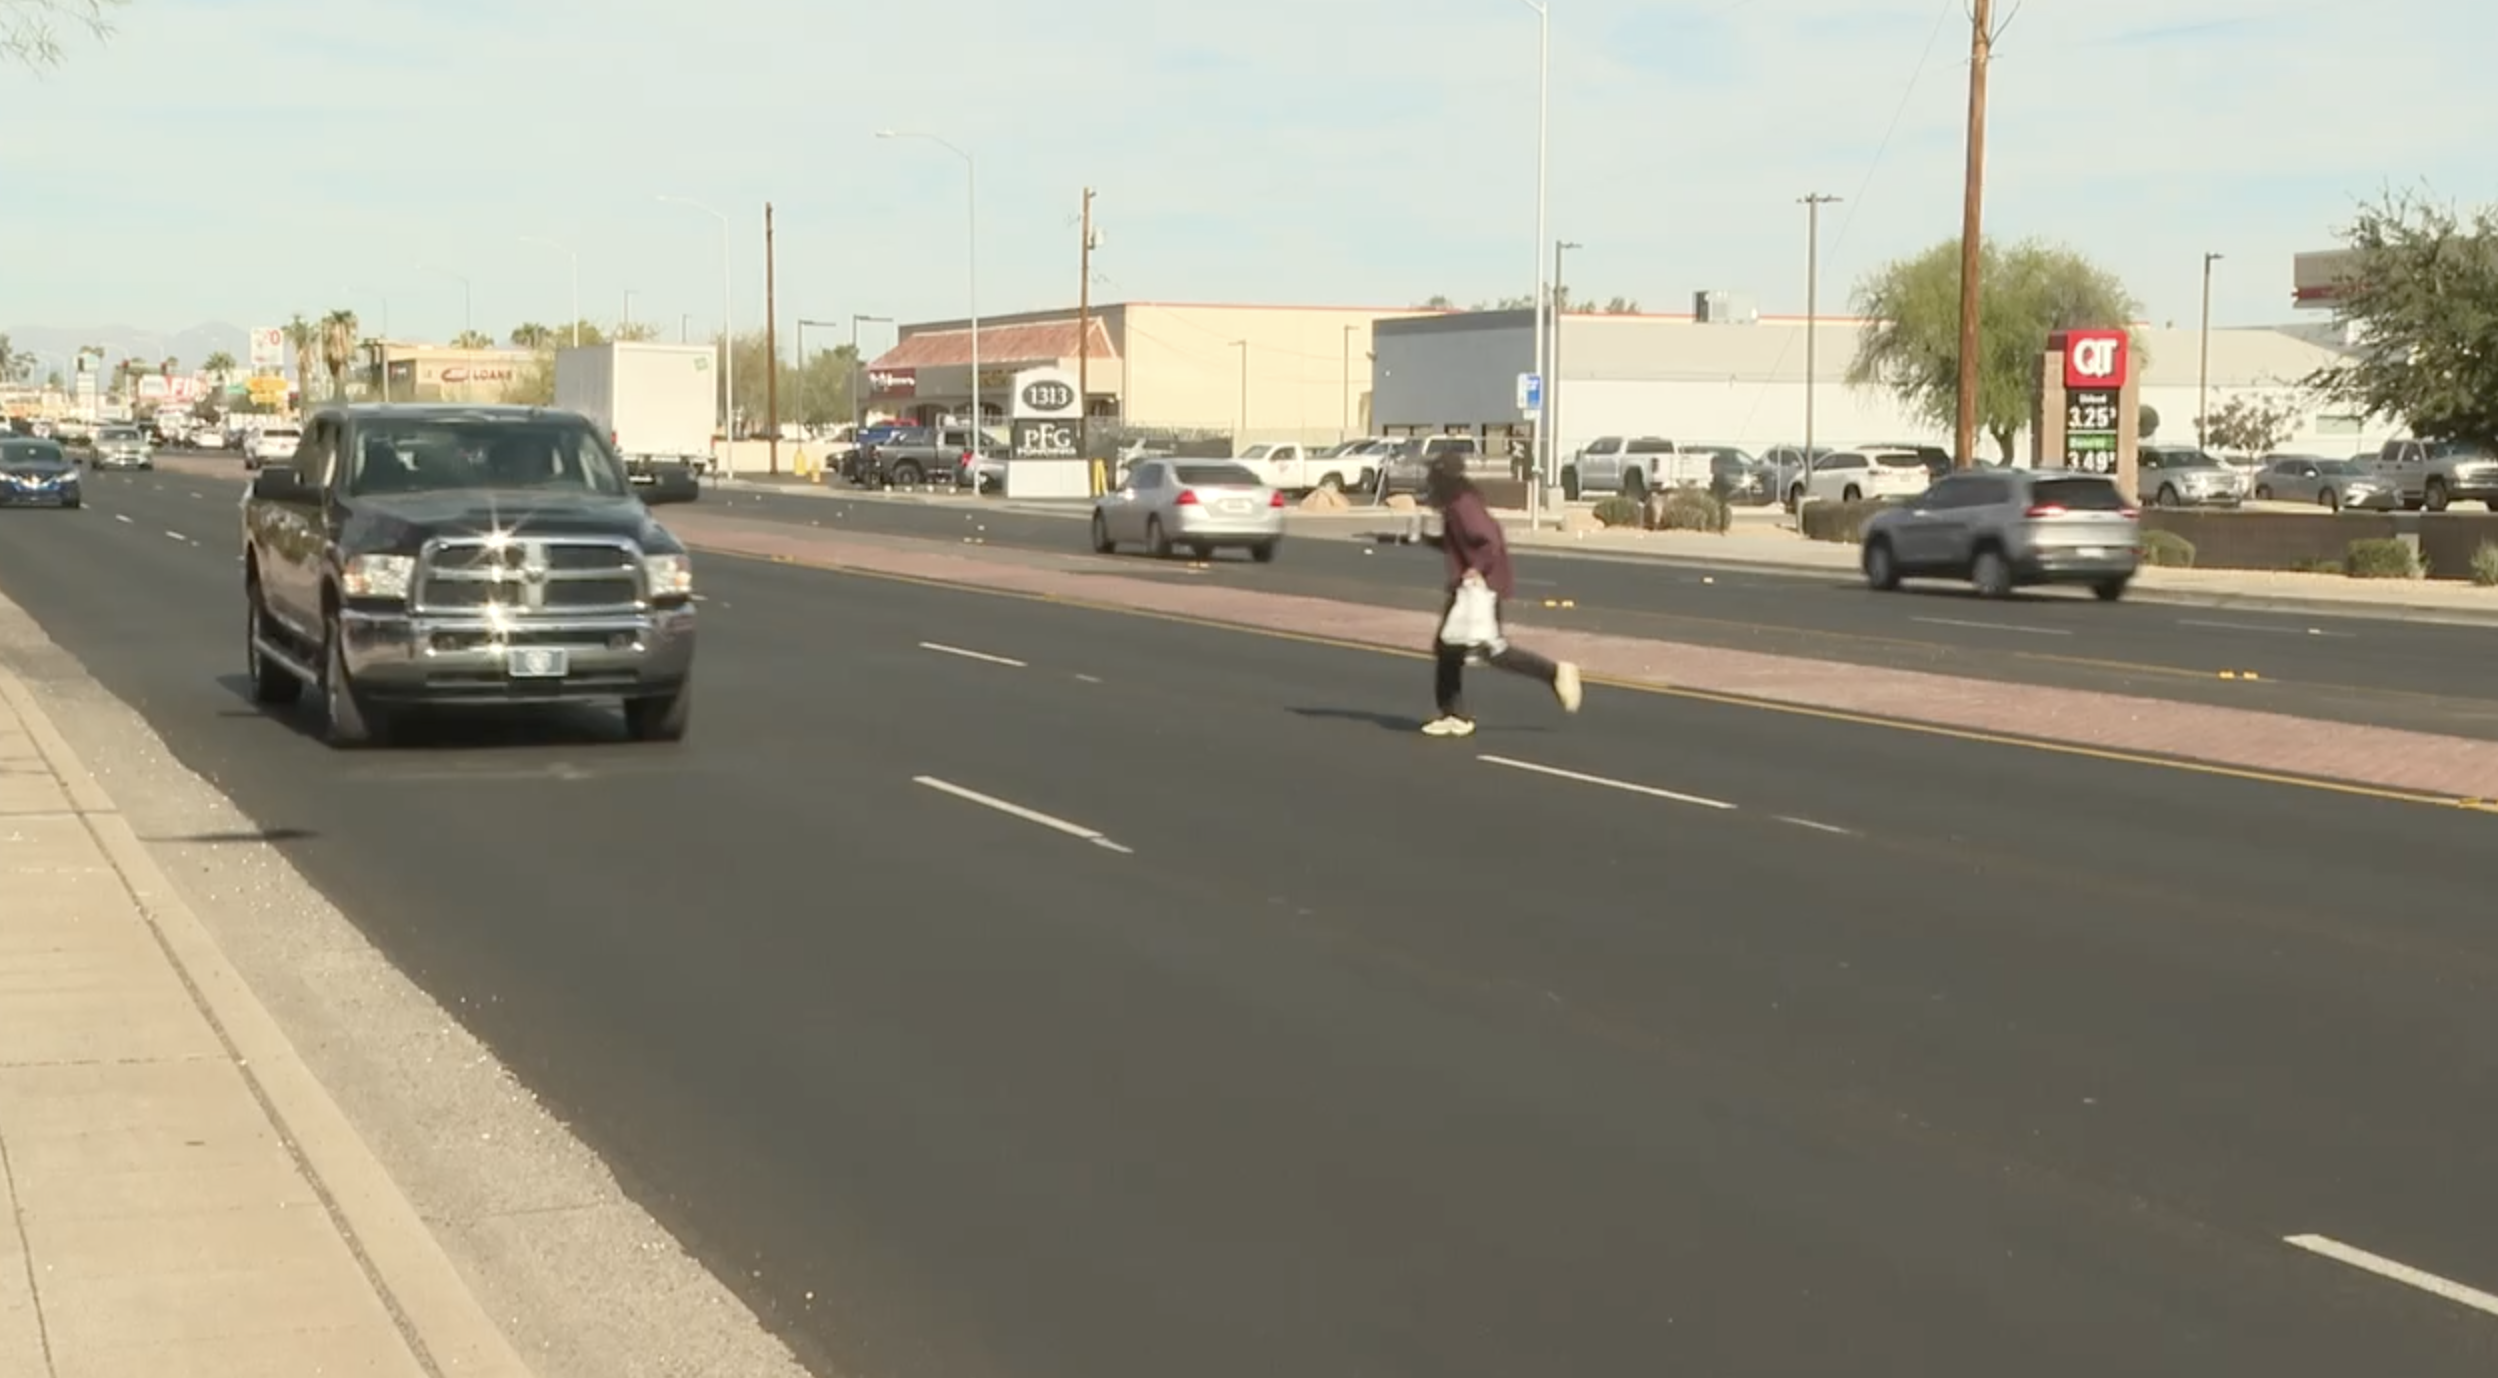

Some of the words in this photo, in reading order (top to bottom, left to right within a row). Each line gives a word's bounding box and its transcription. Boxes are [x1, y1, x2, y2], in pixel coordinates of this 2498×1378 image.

[2073, 338, 2118, 378] QT
[1030, 386, 1067, 405] 1313
[1025, 423, 1071, 452] PFG
